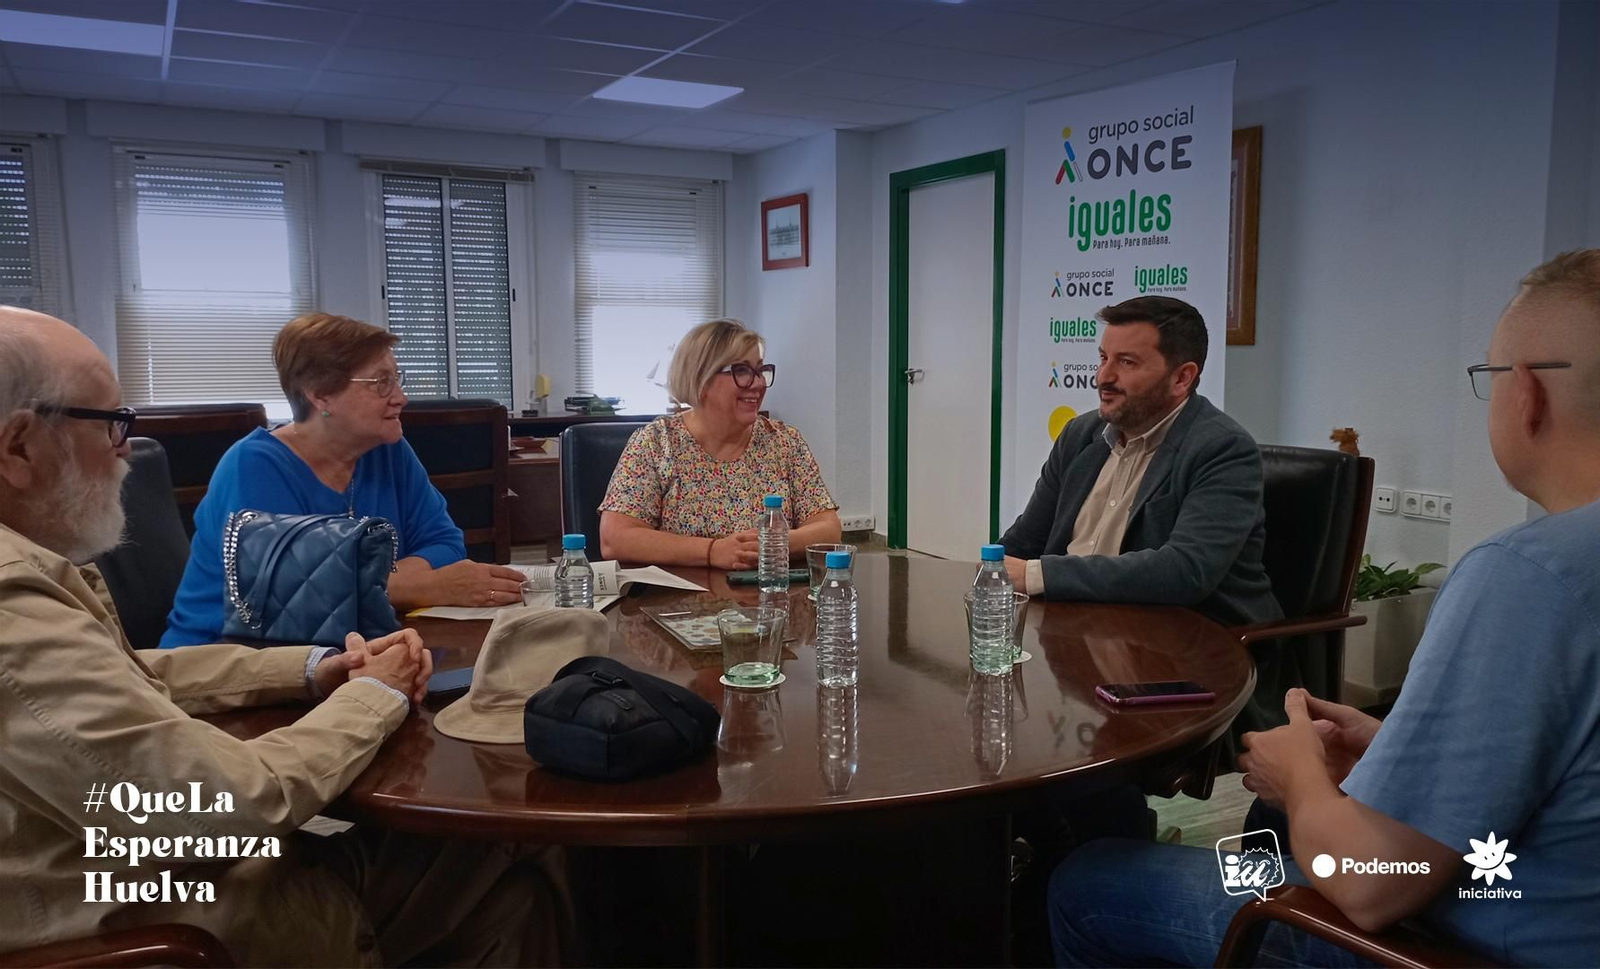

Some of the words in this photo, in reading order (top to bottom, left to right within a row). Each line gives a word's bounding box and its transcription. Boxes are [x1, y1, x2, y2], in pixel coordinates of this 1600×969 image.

[1088, 120, 1138, 144] grupo
[1143, 105, 1194, 132] social
[1087, 135, 1193, 180] ONCE
[1068, 189, 1171, 252] iguales
[1093, 239, 1108, 250] Para
[1124, 237, 1140, 247] Para
[1066, 271, 1090, 280] grupo
[1091, 268, 1114, 278] social
[1134, 264, 1187, 293] iguales
[1066, 281, 1113, 297] ONCE
[1050, 316, 1096, 343] iguales
[1063, 363, 1087, 372] grupo
